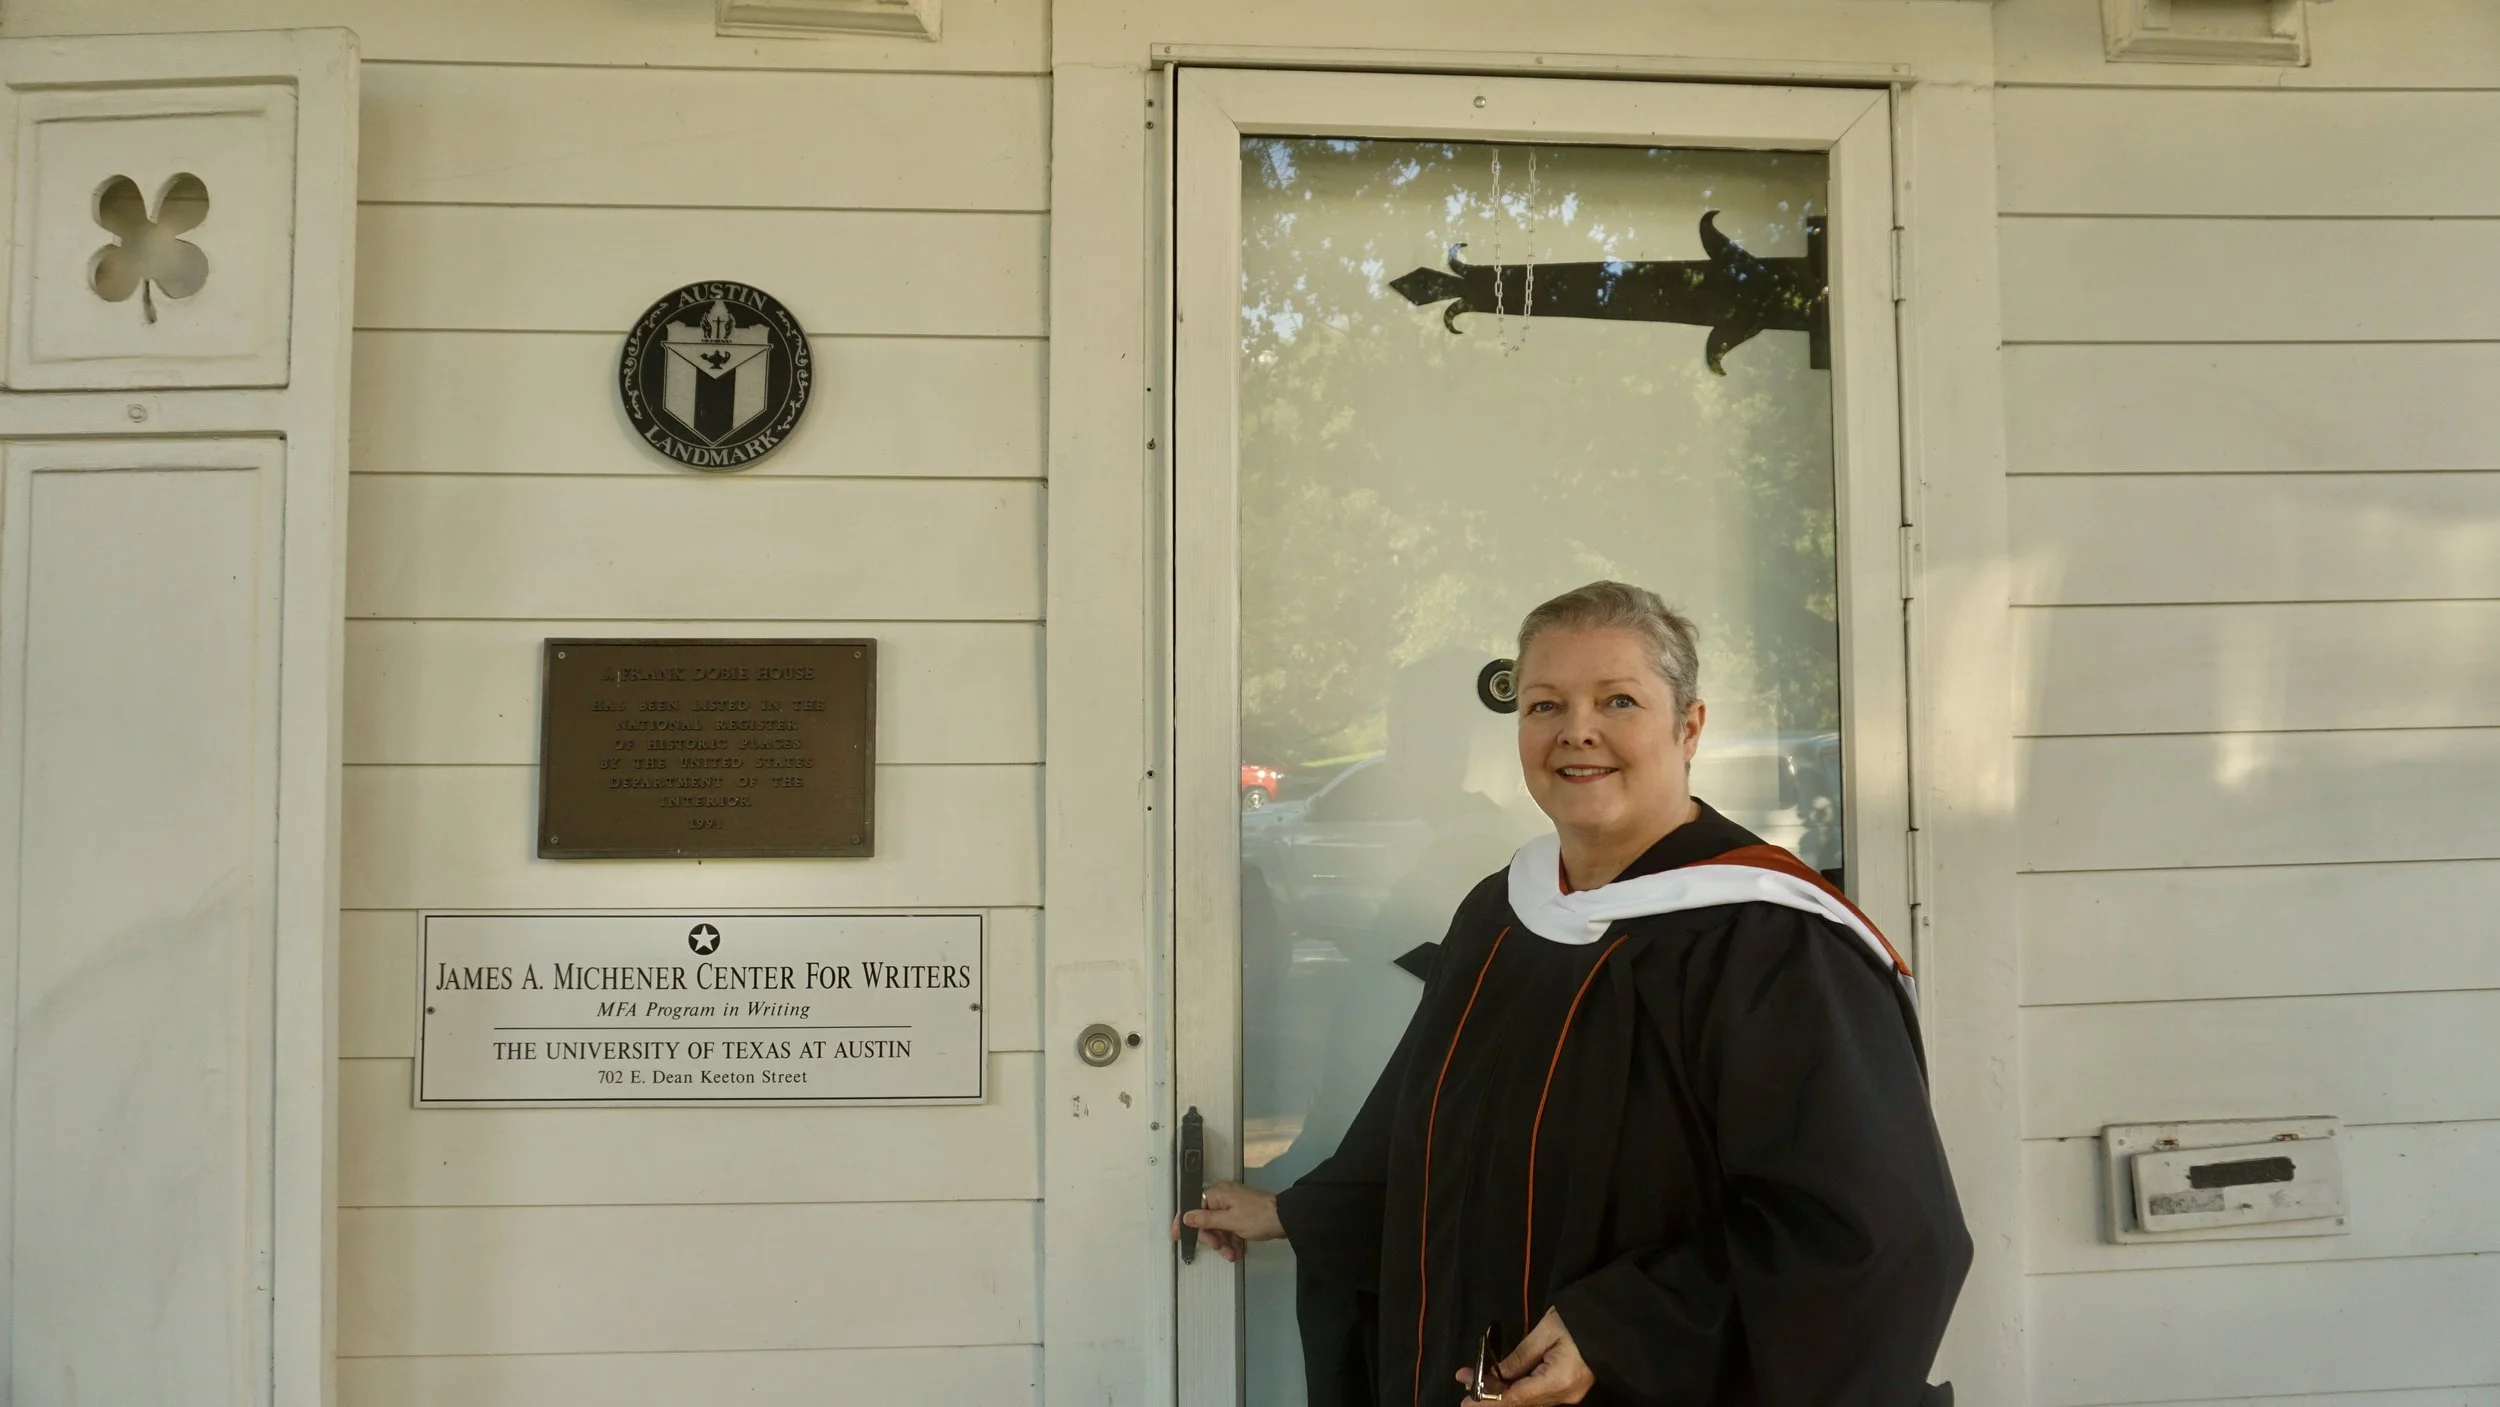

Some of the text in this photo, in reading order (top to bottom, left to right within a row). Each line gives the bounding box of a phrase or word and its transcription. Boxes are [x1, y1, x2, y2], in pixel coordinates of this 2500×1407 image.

[678, 283, 768, 311] AUSTIN
[644, 425, 780, 466] LANDMARK
[620, 667, 686, 681] FRANK
[693, 667, 748, 681] DOBIE
[756, 667, 815, 681] HOUSE
[591, 700, 825, 712] HAS BEEN LISTED IN THE
[616, 719, 799, 731] NATIONAL REGISTER
[613, 739, 801, 751] OF HISTORIC PLACES
[600, 757, 814, 769] BY THE UNITED STATES
[609, 776, 804, 789] DEPARTMENT OF THE
[660, 797, 752, 808] INTERIOR
[436, 961, 971, 991] JAMES A. MICHENER CENTER FOR WRITERS
[596, 1001, 811, 1020] MFA Program in Writing
[493, 1040, 912, 1060] THE UNIVERSITY OF TEXAS AT AUSTIN
[598, 1070, 808, 1084] 702 E. Dean Keeton Street
